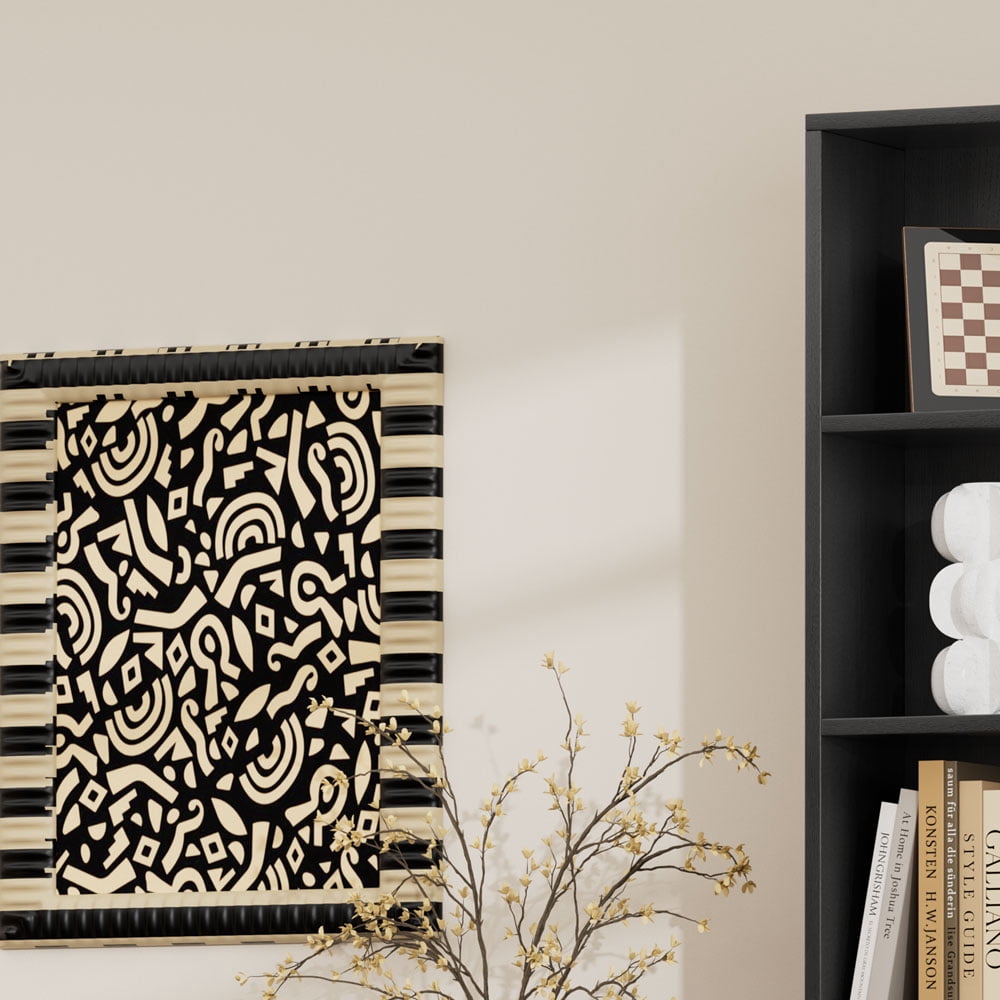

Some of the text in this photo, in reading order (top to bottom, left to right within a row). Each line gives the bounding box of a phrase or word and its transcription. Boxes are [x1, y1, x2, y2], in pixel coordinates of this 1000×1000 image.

[884, 811, 912, 940] At Home in Joshua Tree
[946, 823, 957, 843] alla
[946, 846, 957, 865] die
[868, 864, 884, 917] GRISHAM
[922, 805, 937, 991] KONSTEN H.W.JANSON
[963, 833, 976, 980] STYLE GUIDE
